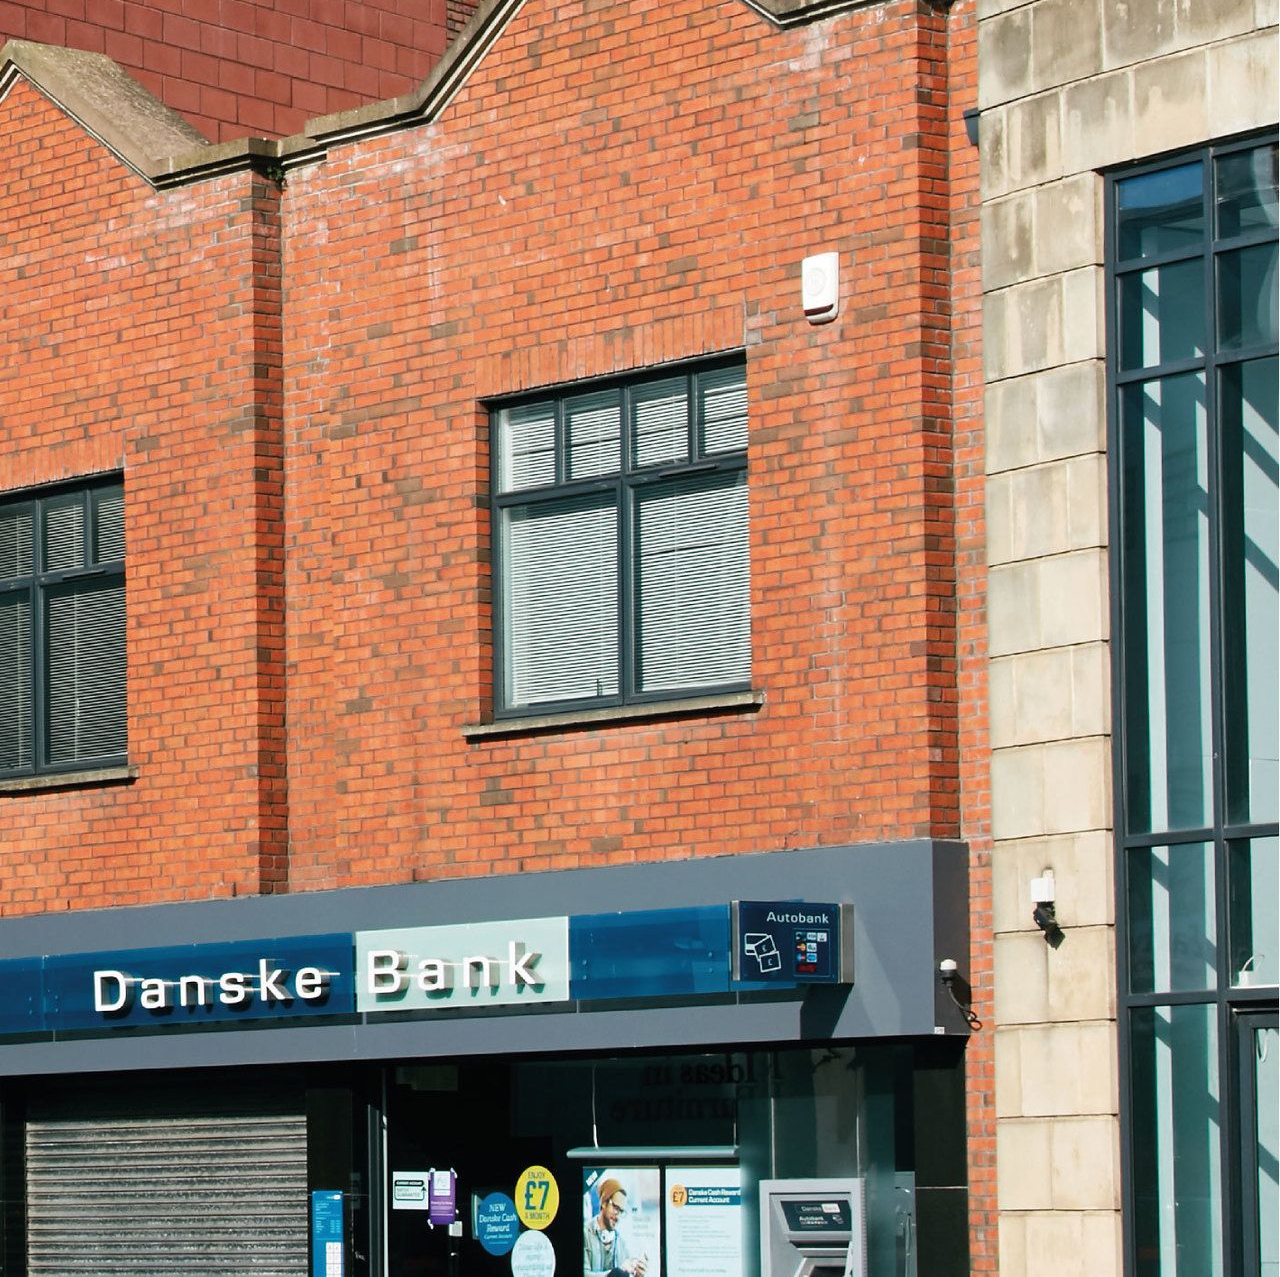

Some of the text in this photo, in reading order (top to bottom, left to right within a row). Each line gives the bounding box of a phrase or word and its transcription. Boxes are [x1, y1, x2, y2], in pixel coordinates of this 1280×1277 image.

[766, 911, 829, 924] Autobank
[93, 941, 541, 1012] Danske Bank
[524, 1180, 550, 1210] £7
[672, 1191, 684, 1203] £7
[489, 1203, 506, 1212] NEW
[479, 1213, 517, 1223] Danske Cash
[486, 1224, 510, 1232] Reward
